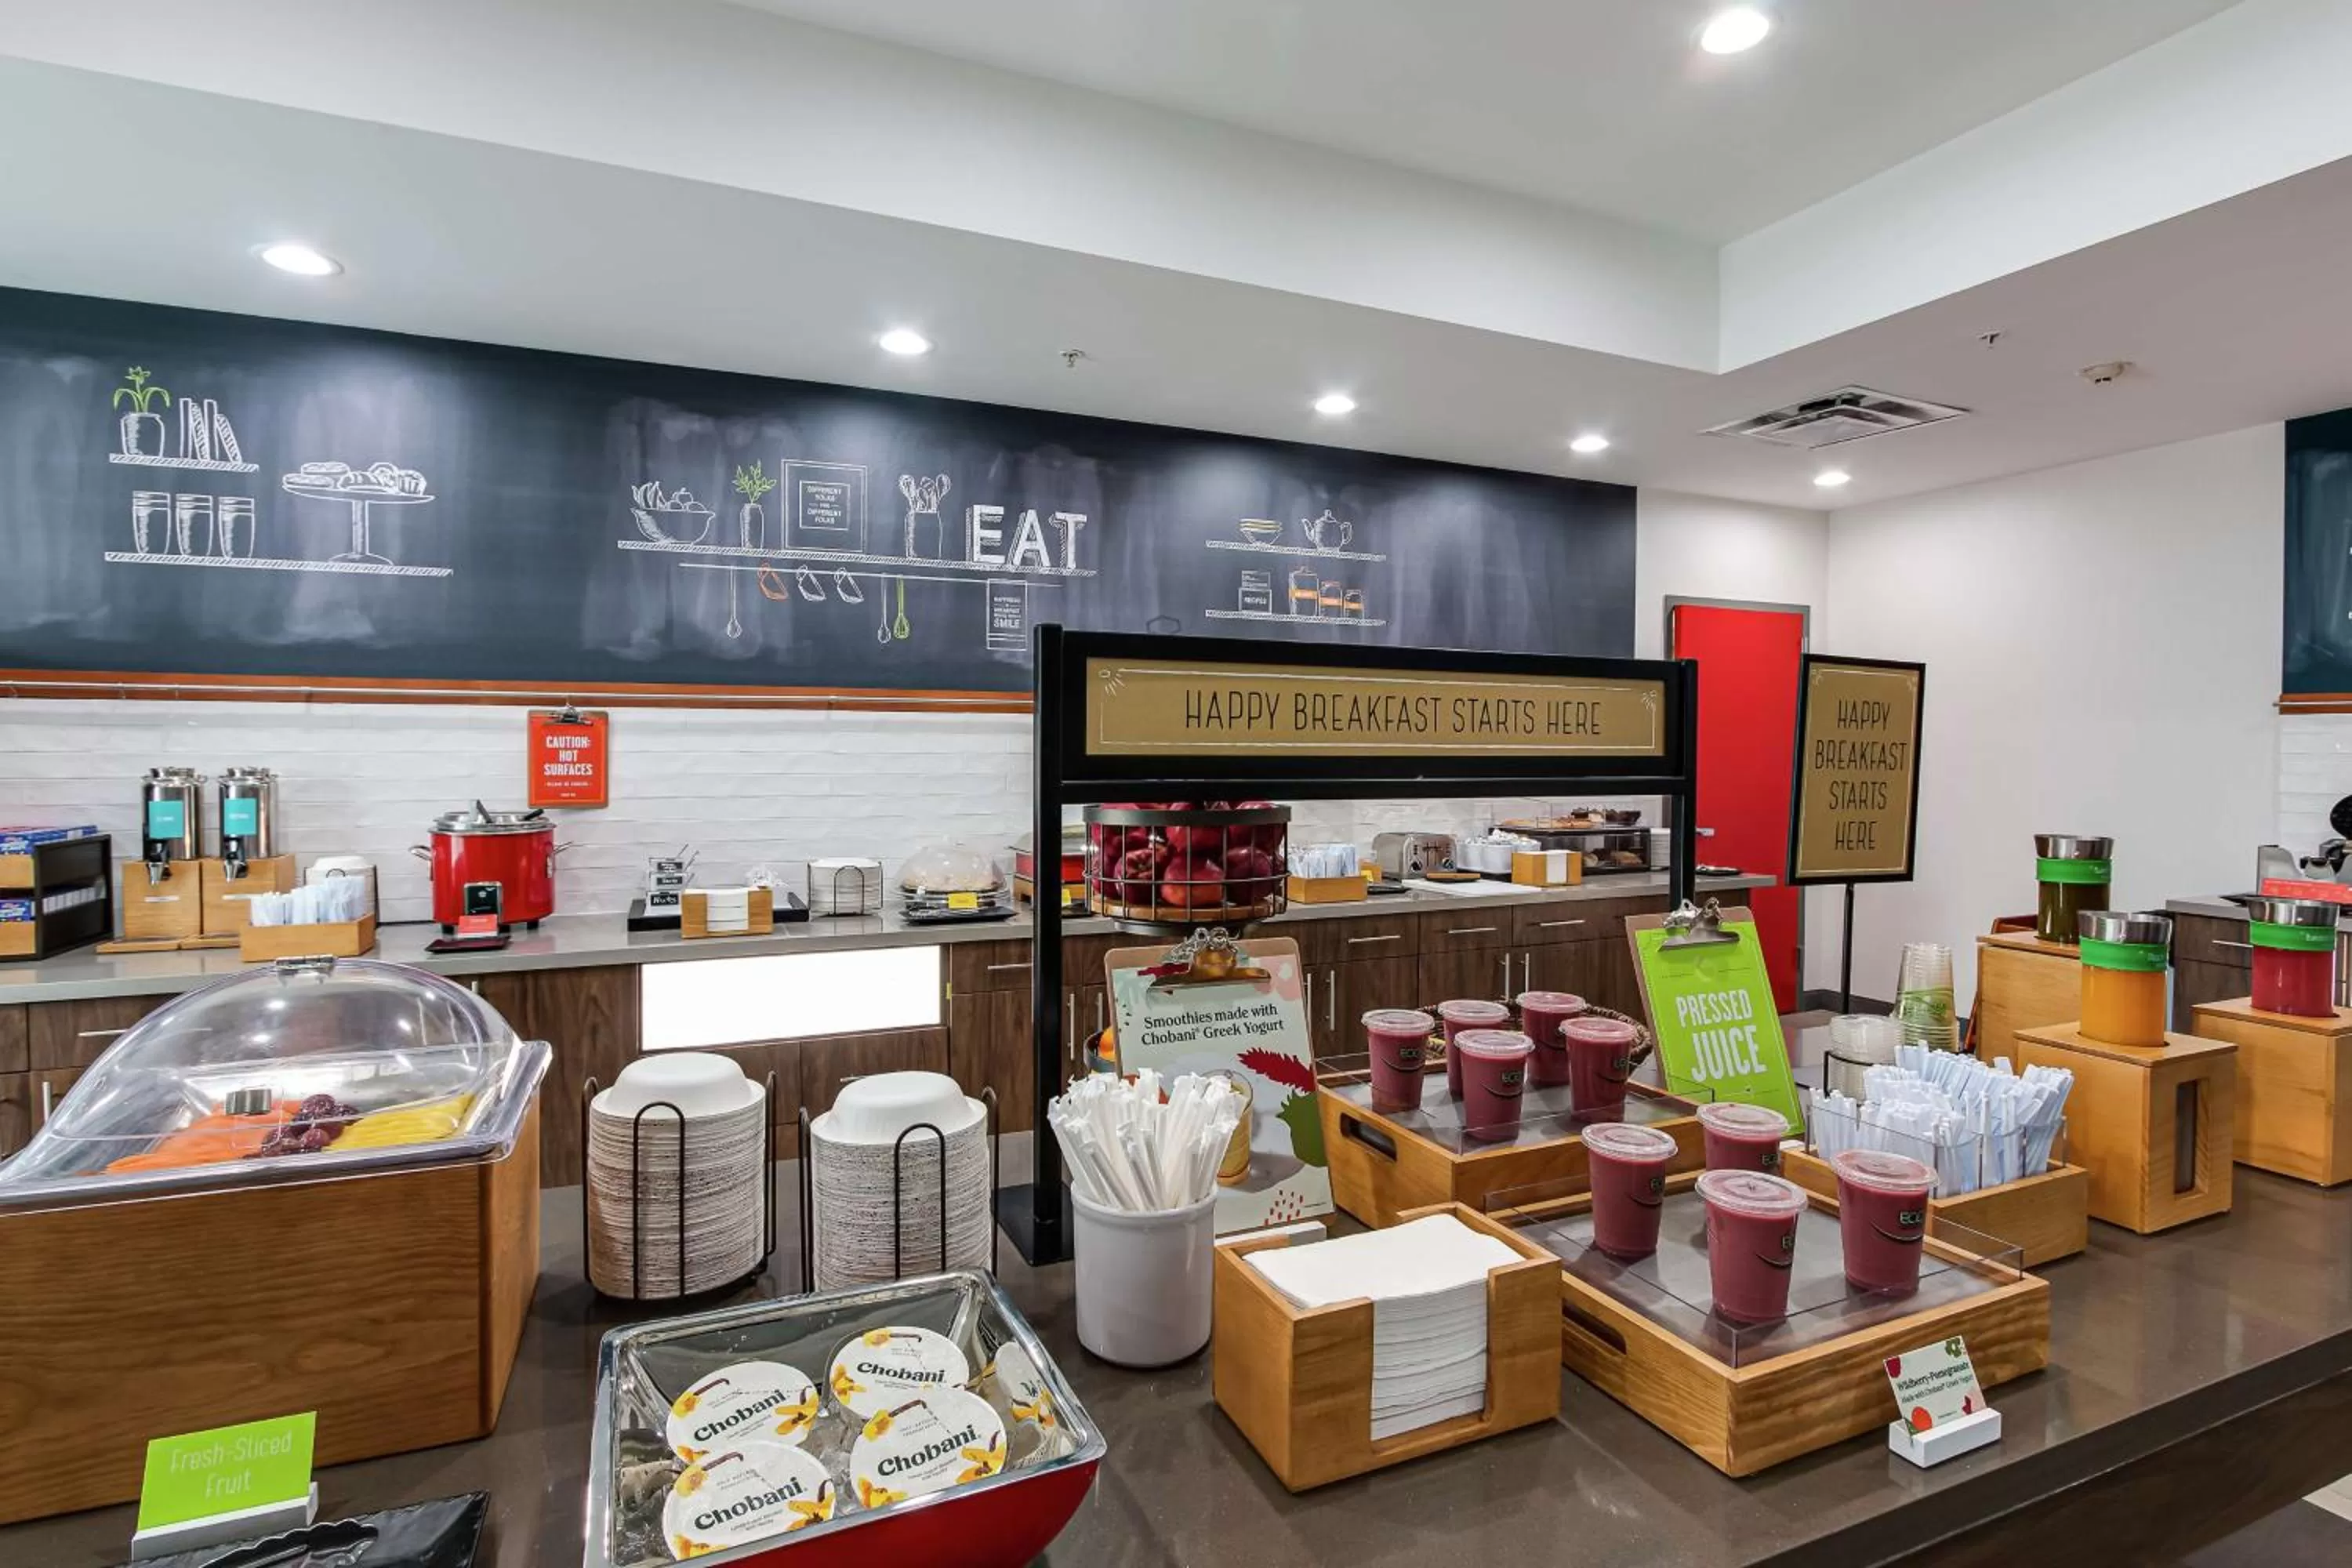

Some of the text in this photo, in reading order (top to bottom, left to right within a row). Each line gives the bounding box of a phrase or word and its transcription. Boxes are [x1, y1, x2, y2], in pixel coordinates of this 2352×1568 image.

[966, 504, 1087, 570] EAT
[993, 618, 1020, 628] SMILE
[1185, 689, 1602, 735] HAPPY BREAKFAST STARTS HERE
[1837, 699, 1890, 731] HAPPY
[543, 763, 593, 775] SURFACES
[558, 750, 578, 762] HOT
[1815, 739, 1907, 771] BREAKFAST
[1829, 780, 1888, 811] STARTS
[1835, 821, 1878, 851] HERE
[1144, 1003, 1278, 1029] Smoothies made with
[1675, 989, 1753, 1028] PRESSED
[1203, 1023, 1242, 1039] Greek
[1244, 1019, 1284, 1035] Yogurt
[1691, 1025, 1768, 1082] JUICE
[857, 1362, 945, 1383] Chobani
[694, 1389, 787, 1442] Chobani
[877, 1425, 977, 1476] Chobani
[205, 1468, 252, 1499] Fruit
[694, 1476, 804, 1530] Chobani
